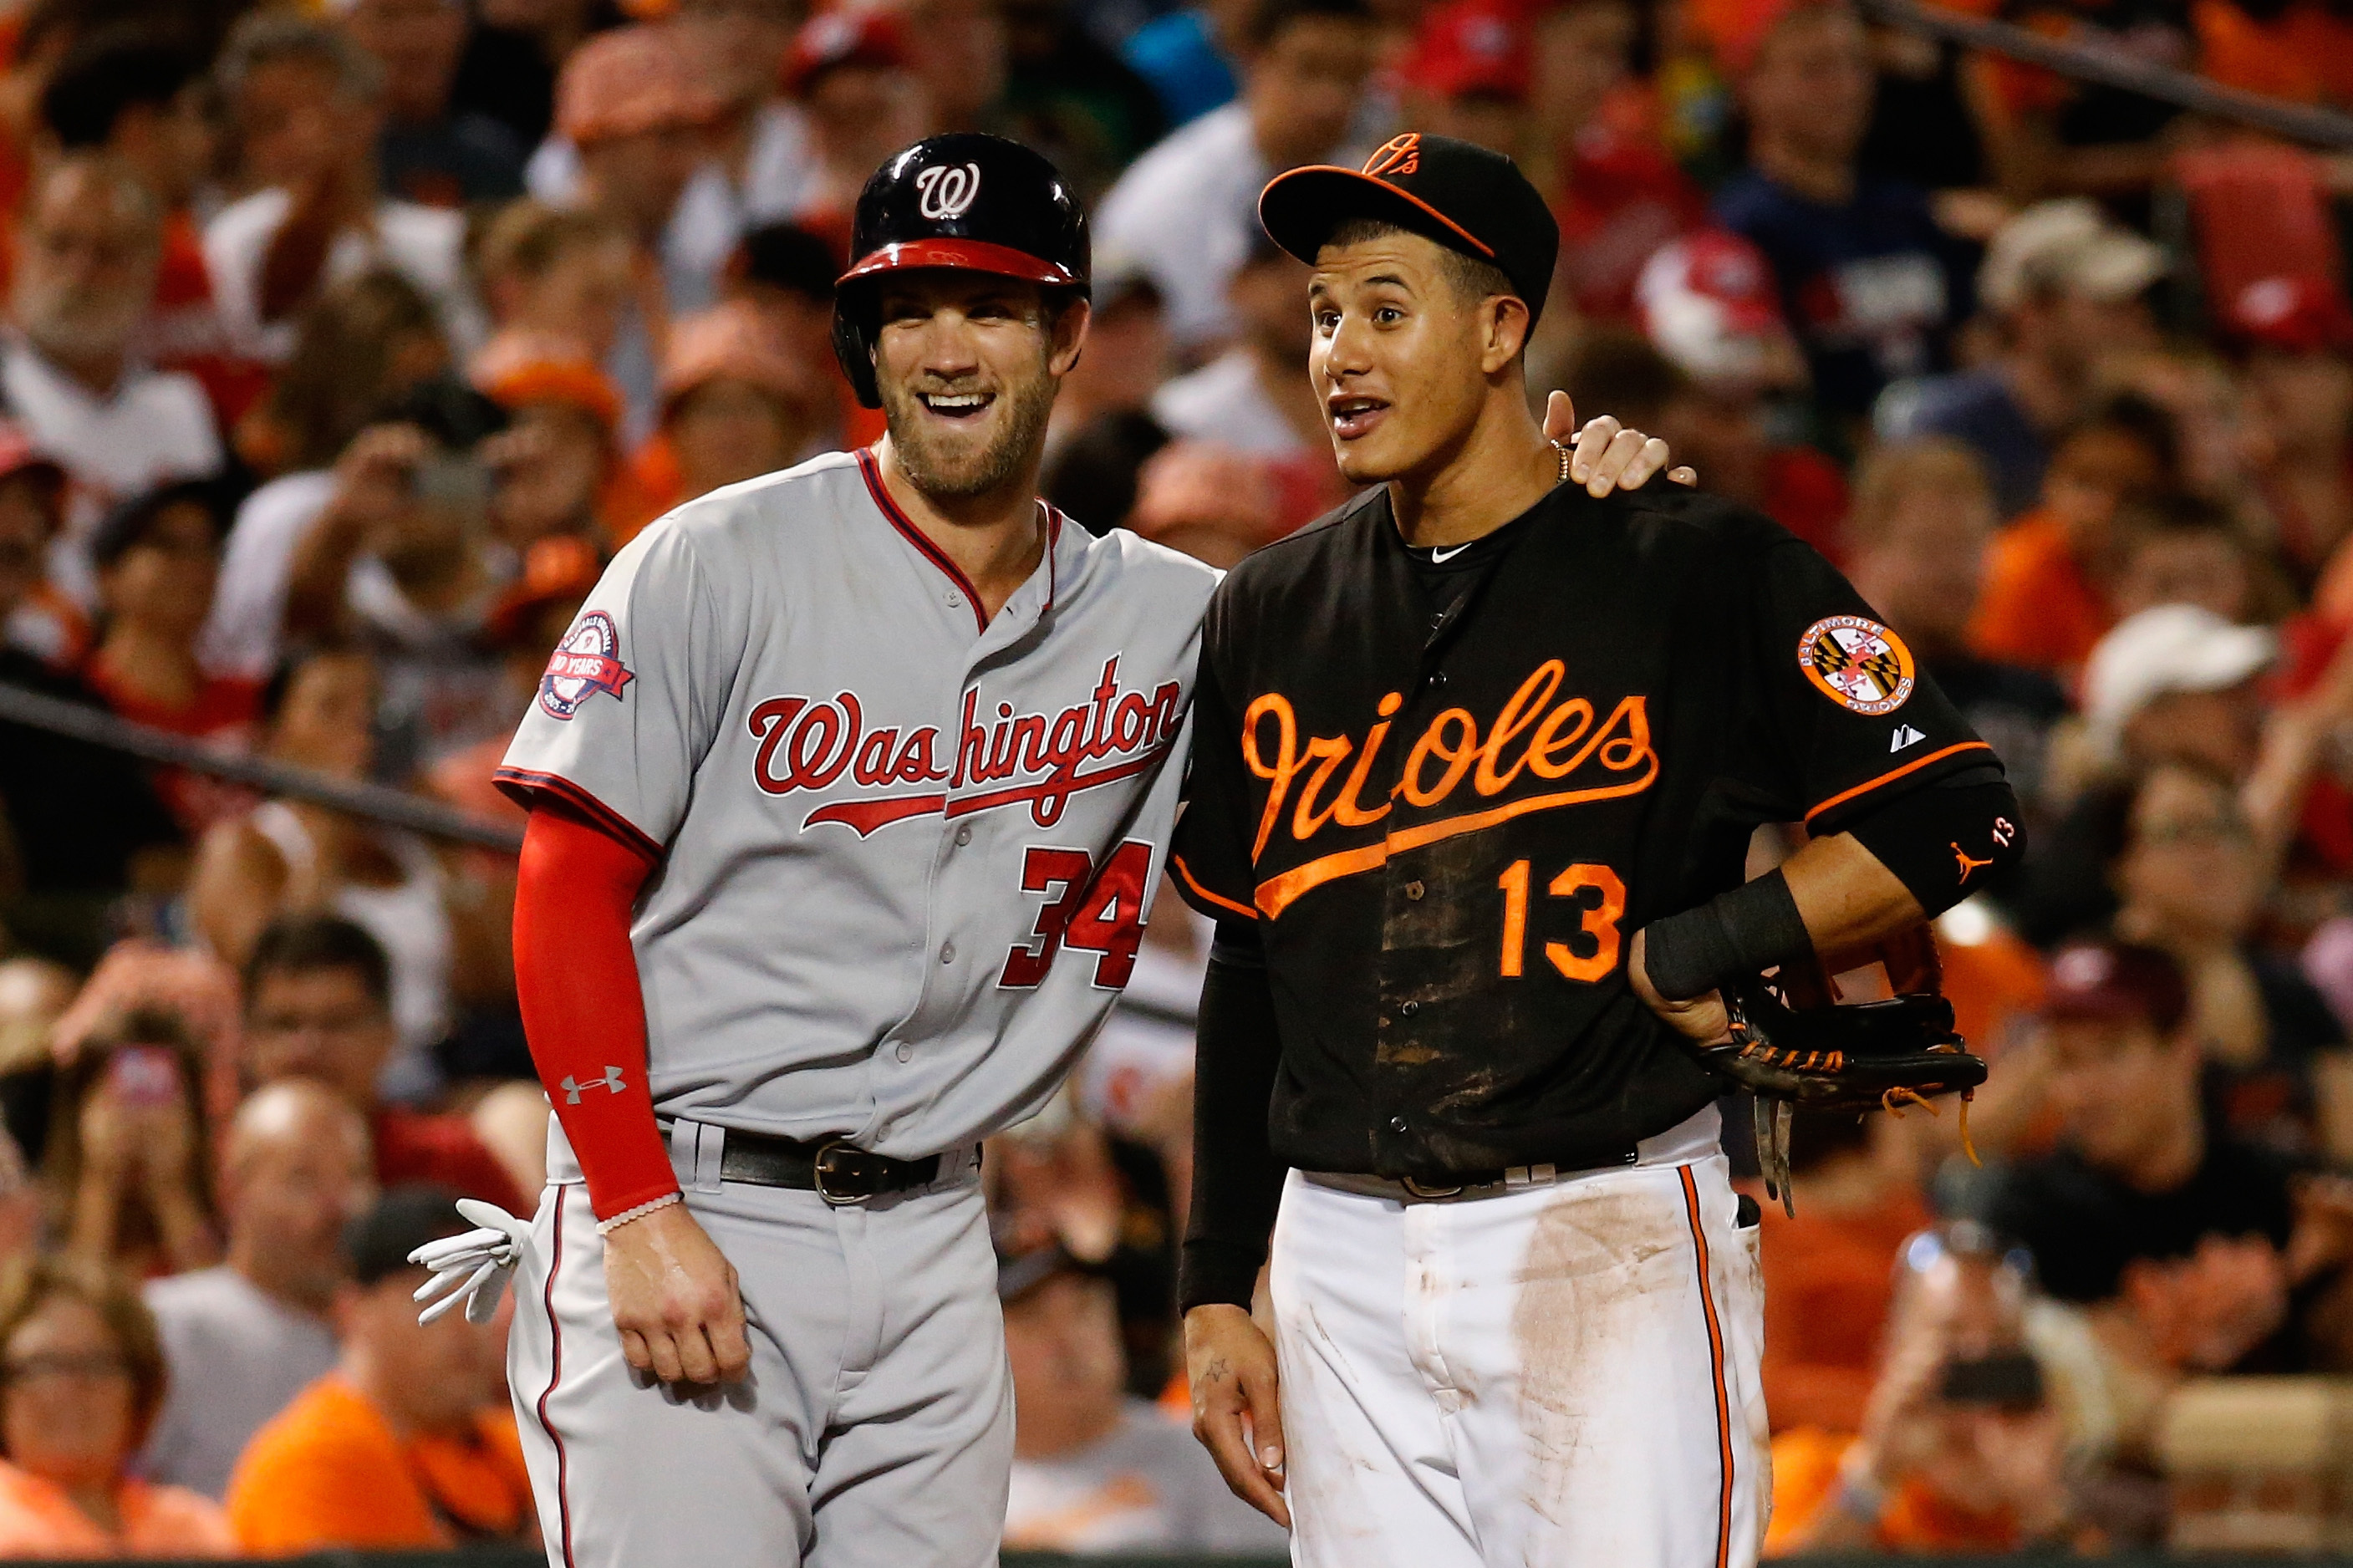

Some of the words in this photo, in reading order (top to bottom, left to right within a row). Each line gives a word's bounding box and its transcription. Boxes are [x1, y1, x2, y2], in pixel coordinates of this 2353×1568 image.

[915, 162, 980, 219] W
[551, 654, 568, 671] 10
[567, 657, 604, 676] YEARS
[1800, 617, 1885, 667] BALTIMORE
[1846, 677, 1912, 711] ORIOLES
[746, 651, 1184, 828] Washington
[1242, 659, 1655, 870] Orioles
[1992, 817, 2014, 848] 13
[996, 836, 1155, 991] 34
[1498, 858, 1627, 983] 13
